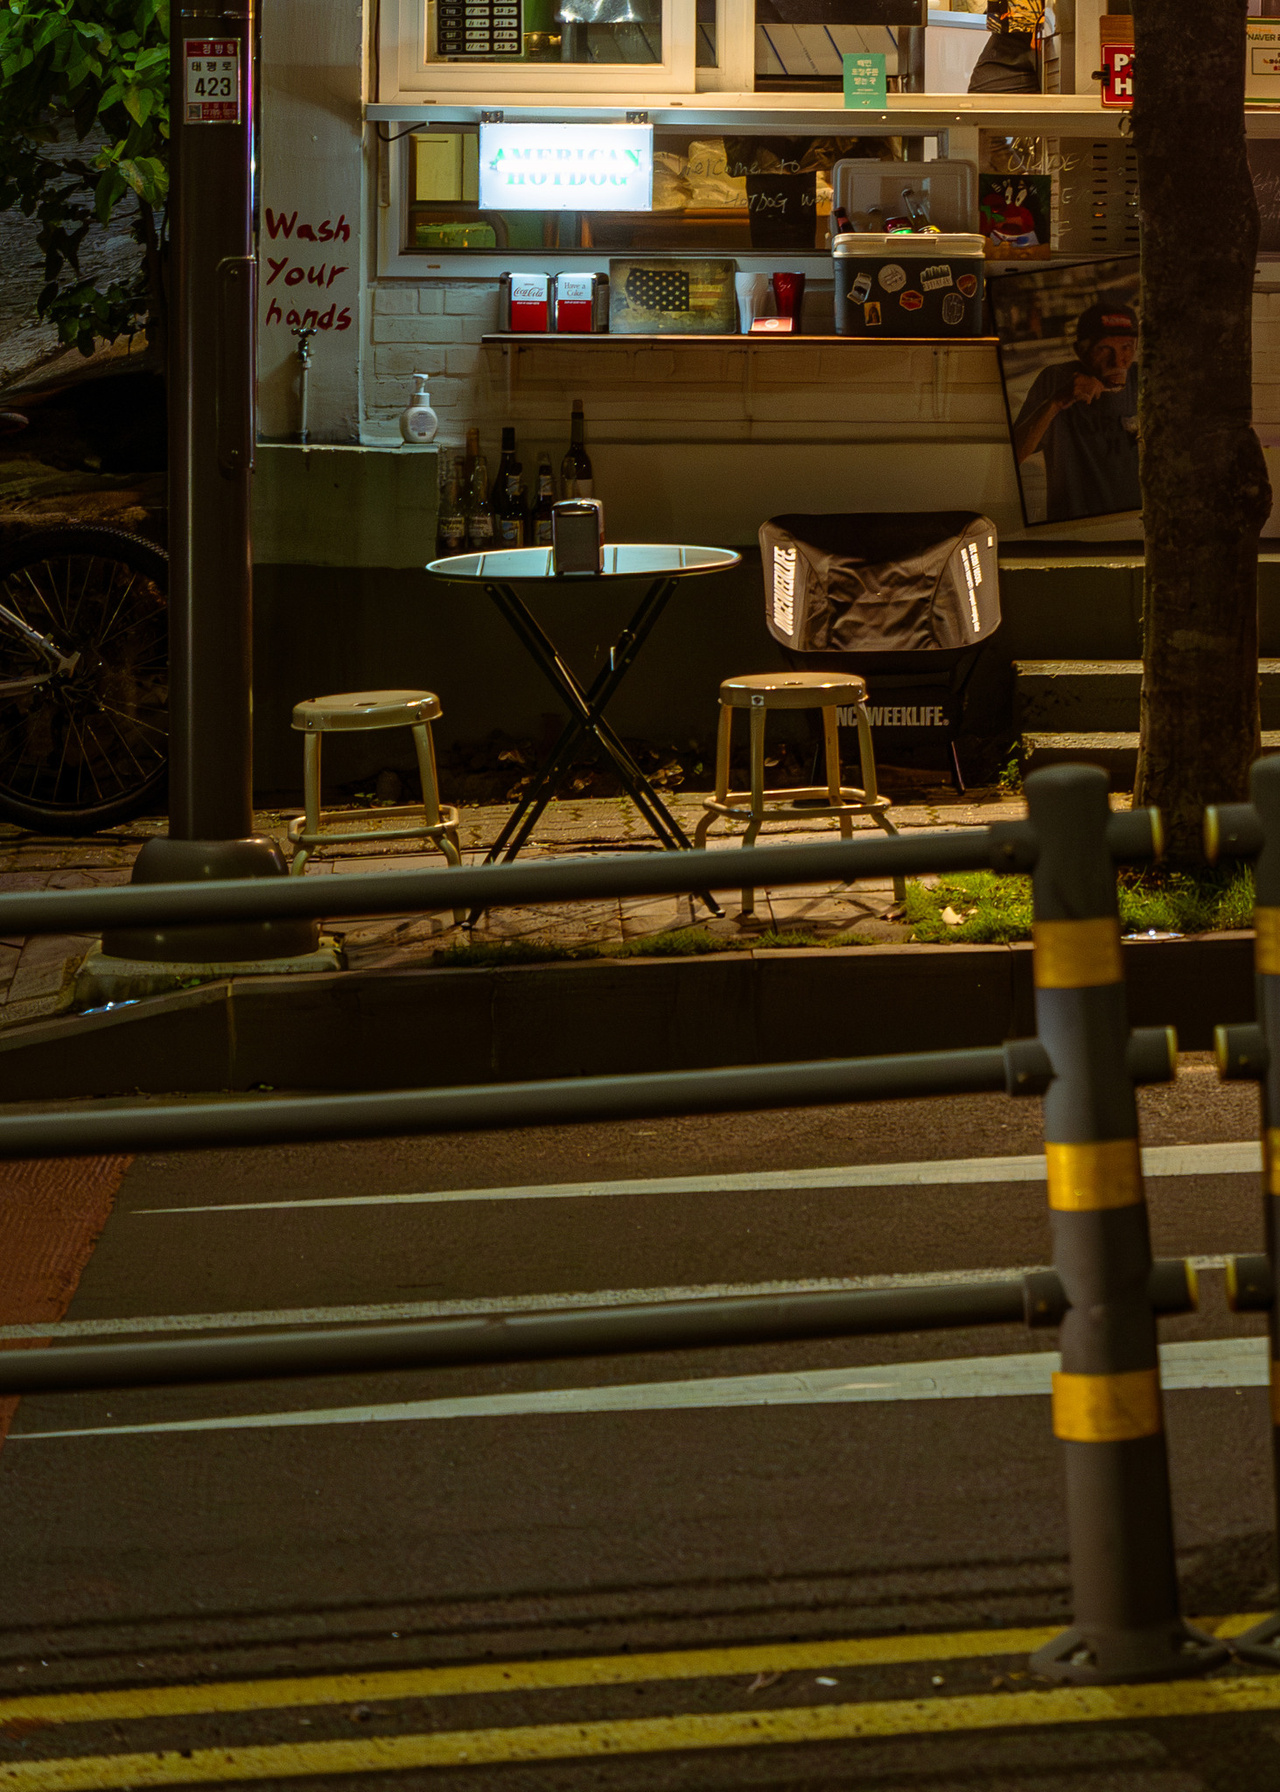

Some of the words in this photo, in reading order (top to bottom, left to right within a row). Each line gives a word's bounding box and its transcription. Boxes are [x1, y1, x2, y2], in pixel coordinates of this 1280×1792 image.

[1247, 34, 1276, 42] NAVER
[192, 61, 233, 72] 태평로
[194, 77, 232, 97] 423
[265, 207, 351, 243] Wash
[265, 297, 352, 331] hands
